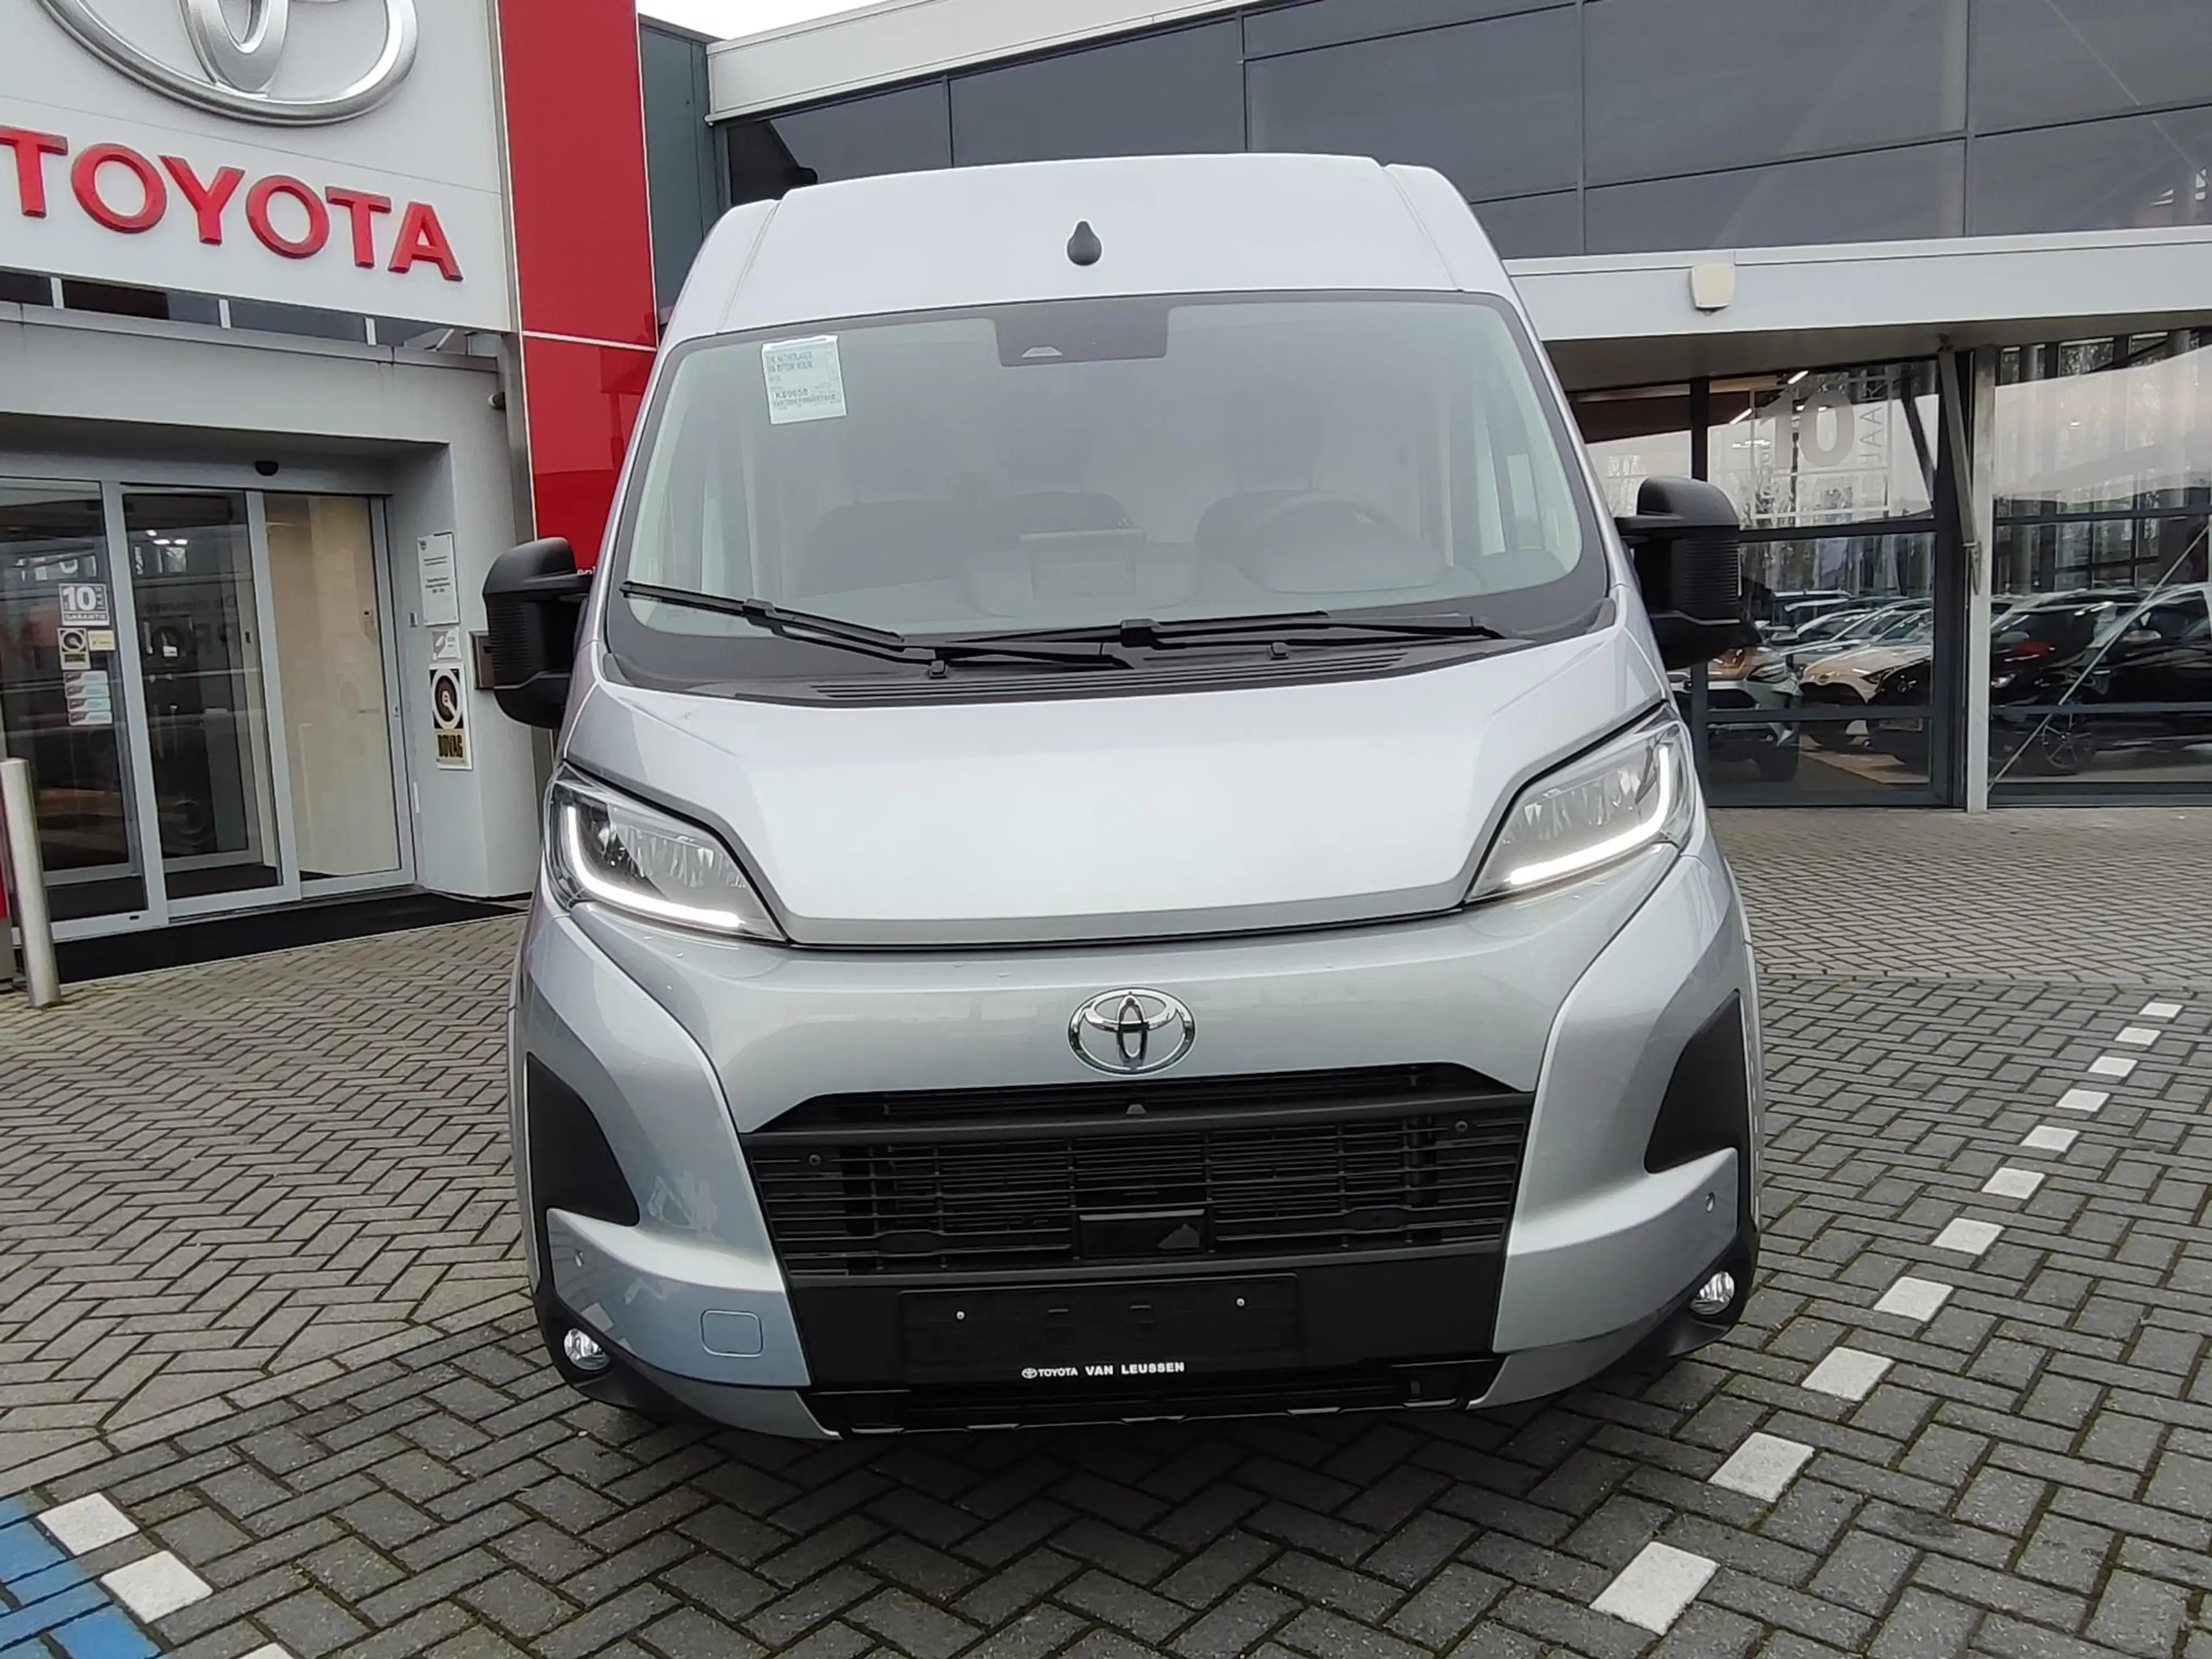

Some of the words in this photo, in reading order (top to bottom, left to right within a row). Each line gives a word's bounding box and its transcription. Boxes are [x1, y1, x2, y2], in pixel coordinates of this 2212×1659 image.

[0, 125, 463, 282] TOYOTA
[62, 586, 96, 611] 10
[1039, 1367, 1078, 1377] TOYOTA
[1085, 1365, 1113, 1376] VAN
[1121, 1362, 1184, 1374] LEUSSEN
